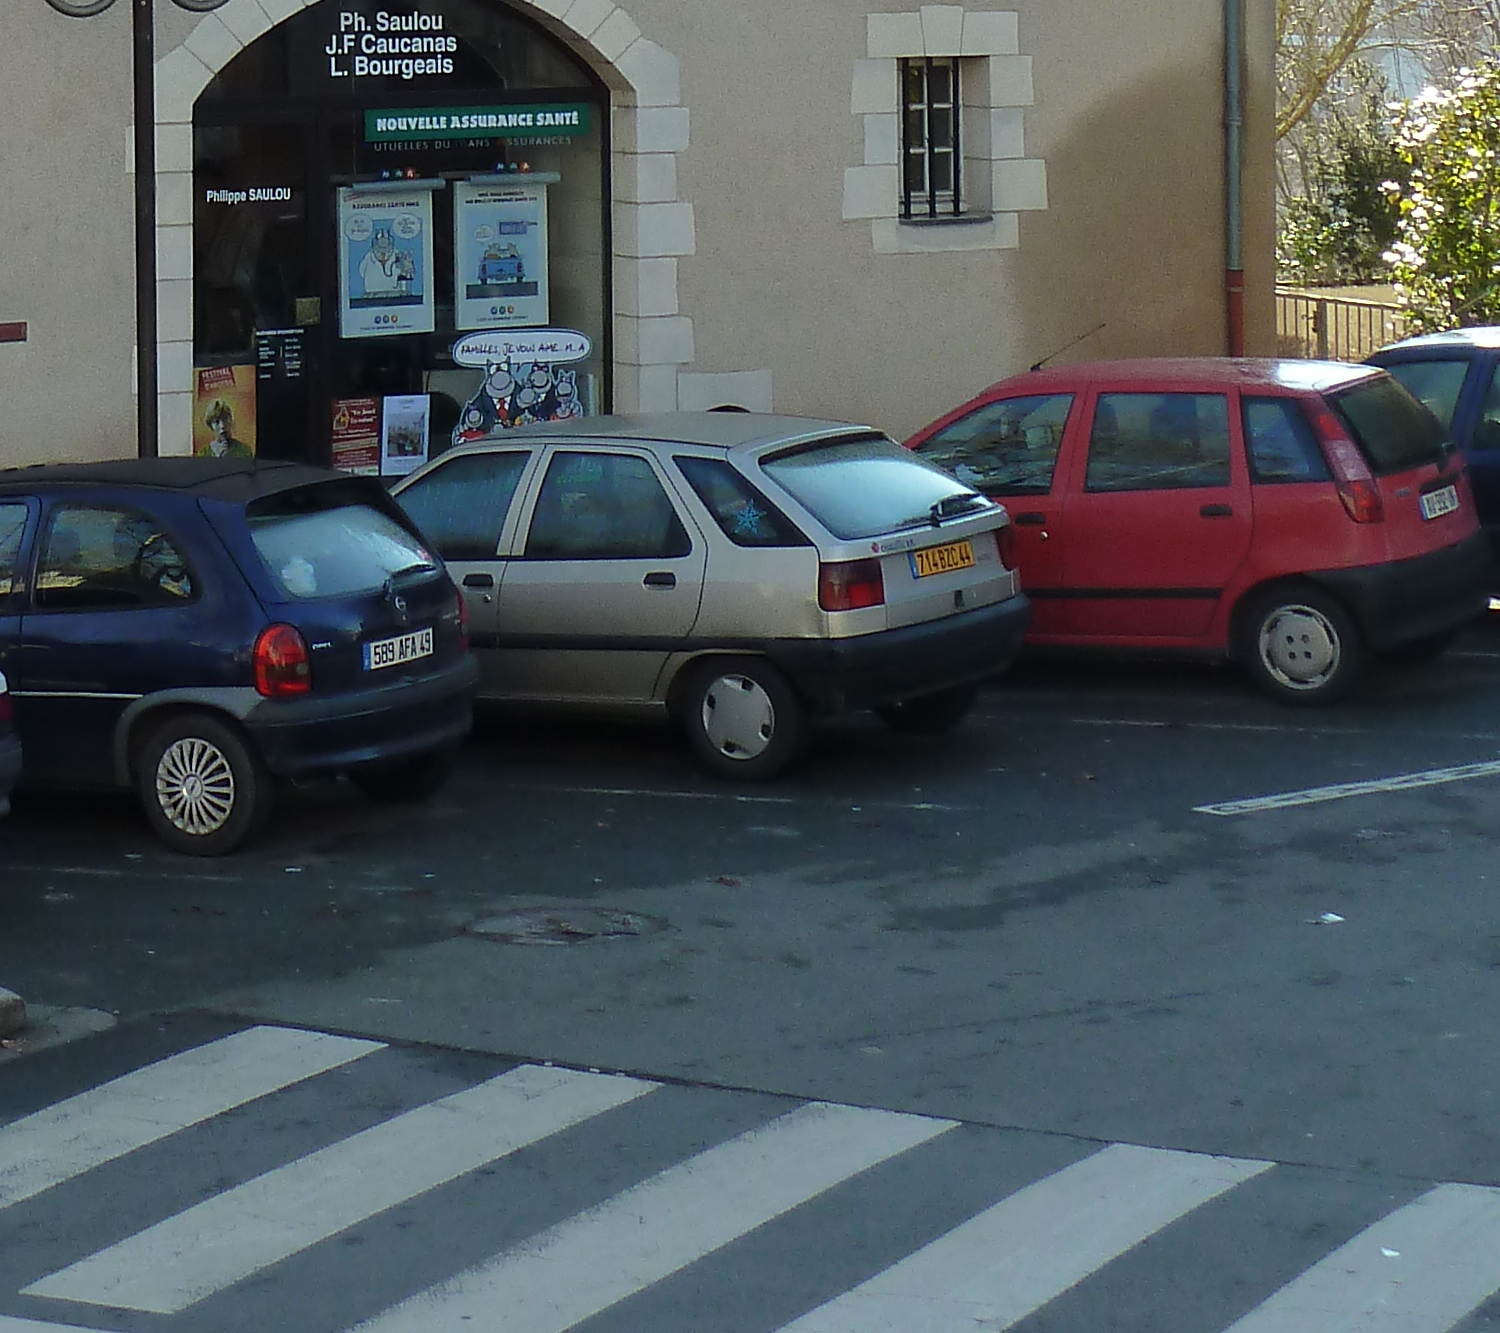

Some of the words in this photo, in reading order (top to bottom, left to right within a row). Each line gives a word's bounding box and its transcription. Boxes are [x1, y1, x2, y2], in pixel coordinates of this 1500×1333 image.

[340, 12, 371, 32] Ph.
[376, 11, 443, 31] Saulou
[325, 34, 355, 54] J.F
[361, 34, 457, 54] Caucanas
[331, 56, 348, 76] L.
[355, 54, 453, 79] Bourgeais
[376, 116, 447, 132] NOUVELLE
[451, 113, 533, 129] ASSURANCE
[537, 110, 579, 126] SANTÉ
[435, 139, 450, 149] DU
[206, 189, 247, 205] Philippe
[249, 187, 291, 201] SAULOU
[917, 552, 938, 574] 714
[373, 641, 395, 666] 589
[398, 637, 417, 660] AFA
[419, 631, 431, 653] 49
